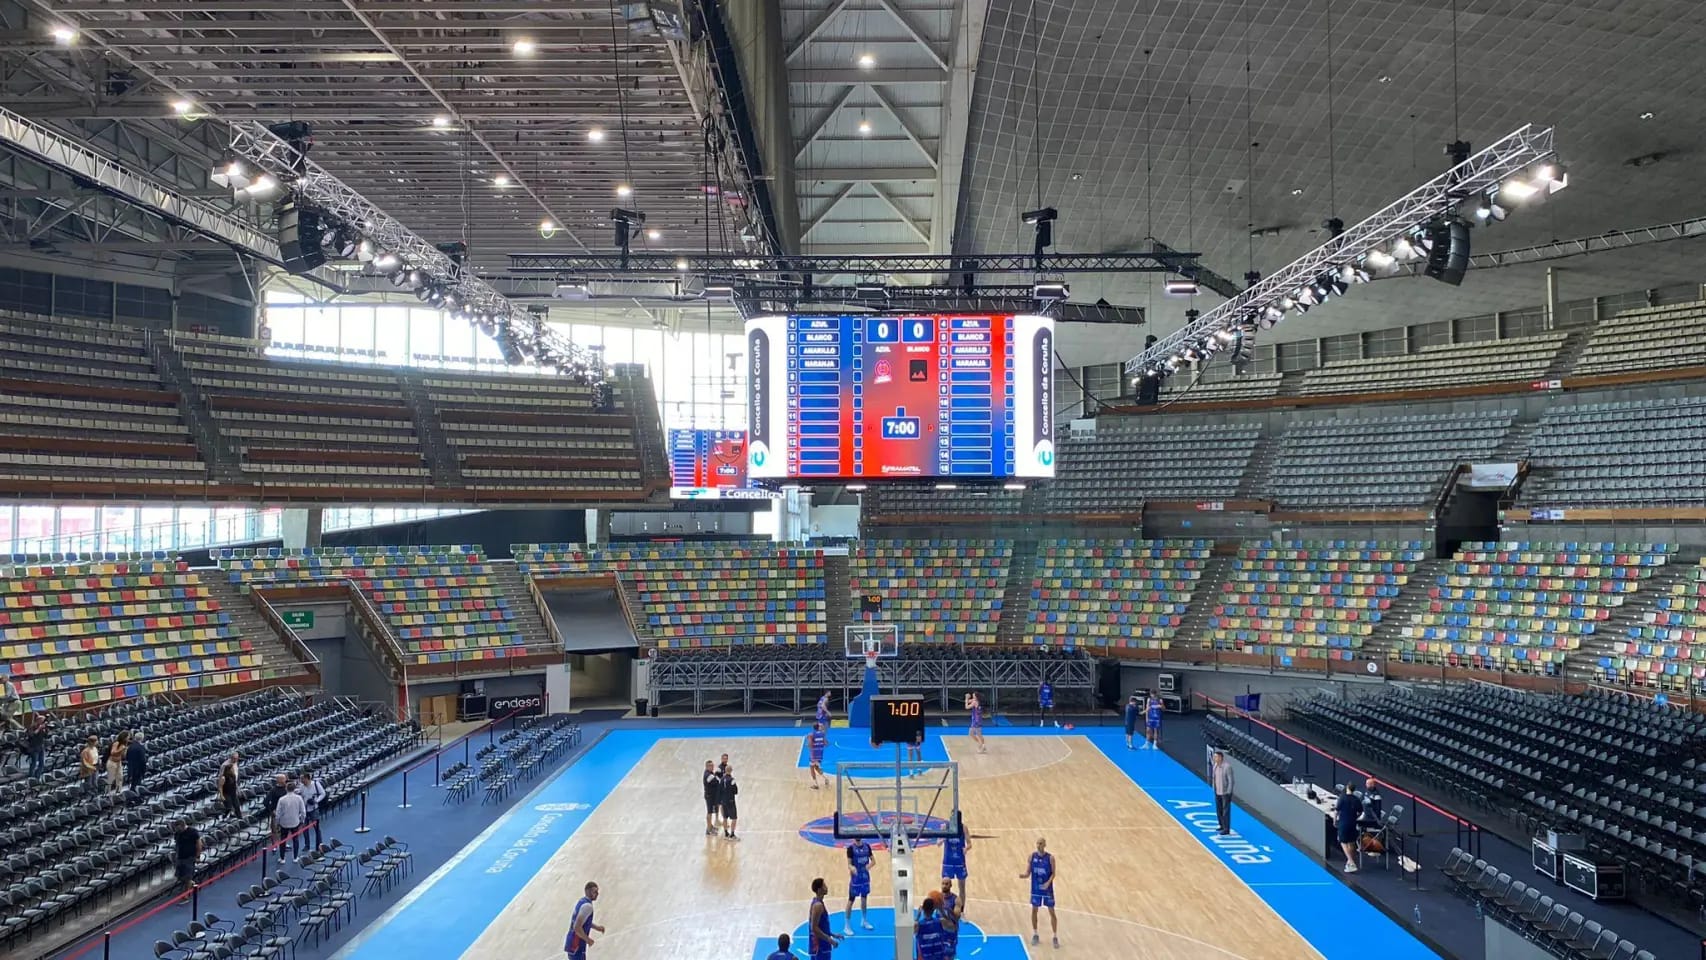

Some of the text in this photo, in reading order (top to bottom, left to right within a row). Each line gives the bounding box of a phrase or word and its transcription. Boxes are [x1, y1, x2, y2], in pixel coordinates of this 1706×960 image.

[878, 322, 888, 338] 0
[913, 322, 924, 338] 0
[754, 378, 760, 390] da
[1042, 377, 1048, 390] da
[887, 421, 915, 435] 7:00
[726, 490, 776, 498] Concello
[494, 698, 540, 709] endesa
[888, 702, 919, 716] 7:00
[1167, 800, 1212, 809] A
